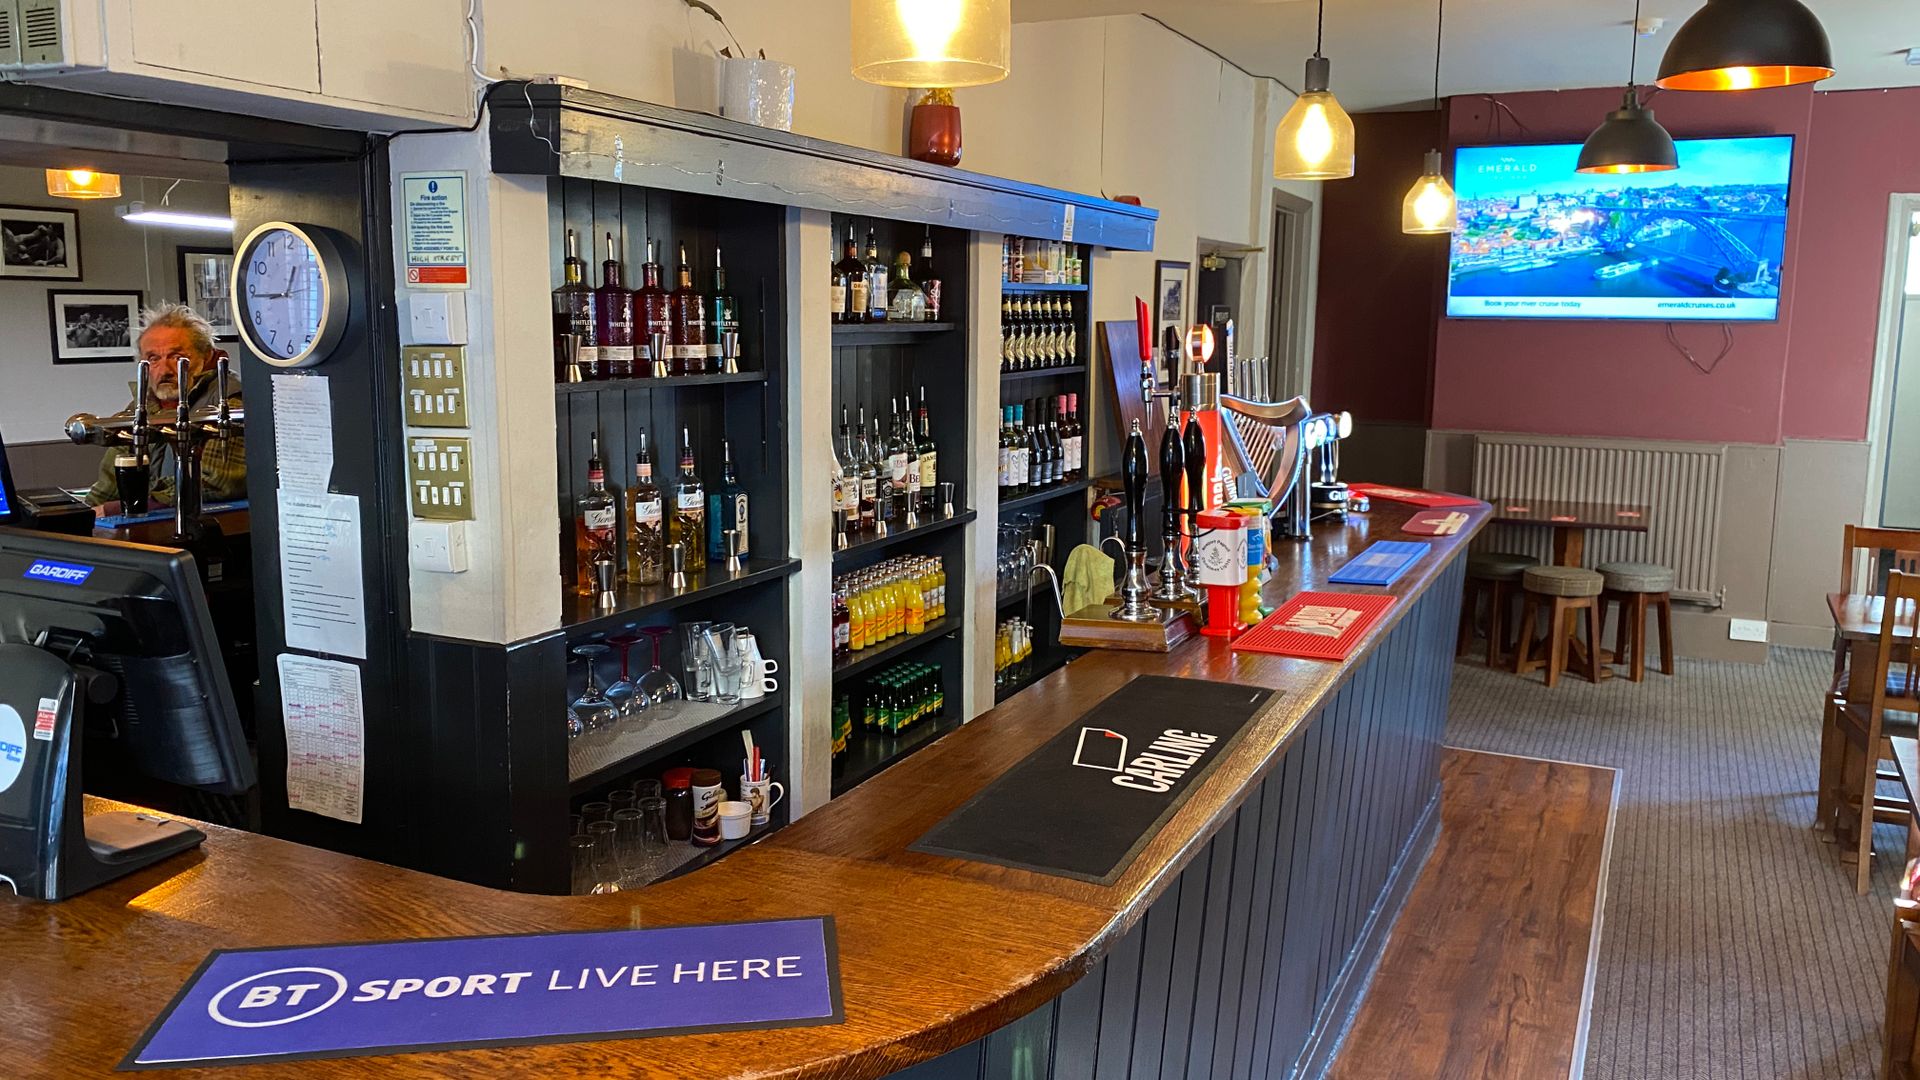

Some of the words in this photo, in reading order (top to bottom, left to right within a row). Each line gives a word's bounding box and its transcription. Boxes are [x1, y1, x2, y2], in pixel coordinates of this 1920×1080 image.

[1478, 163, 1537, 173] EMERALD
[267, 241, 276, 257] 11
[282, 234, 295, 250] 12
[432, 254, 463, 262] STREET
[254, 261, 268, 276] 10
[249, 284, 256, 298] 9
[255, 310, 262, 326] 8
[270, 330, 277, 345] 7
[286, 339, 294, 355] 6
[29, 563, 88, 581] GARDIFF
[1112, 728, 1218, 793] CARLING
[238, 983, 321, 1009] BT
[352, 971, 533, 1003] SPORT
[548, 963, 657, 992] LIVE
[671, 956, 803, 984] HERE
